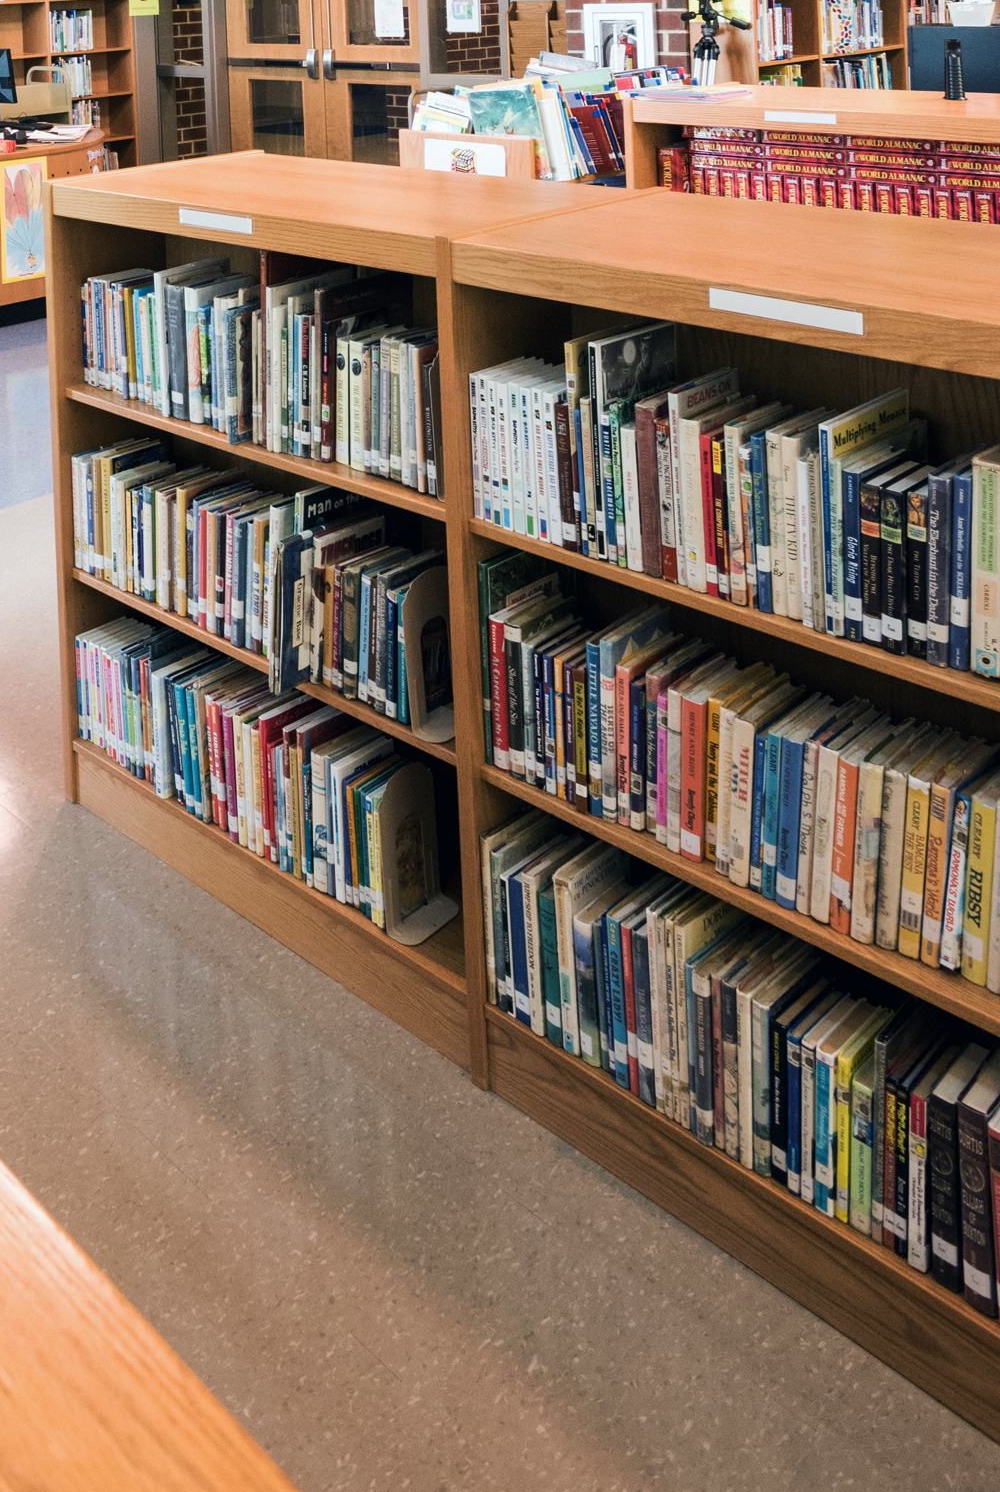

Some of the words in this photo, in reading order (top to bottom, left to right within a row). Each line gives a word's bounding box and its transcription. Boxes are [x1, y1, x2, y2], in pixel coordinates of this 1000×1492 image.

[773, 133, 797, 141] WORLD
[797, 134, 832, 144] ALMANAC
[857, 139, 883, 147] WORLD
[886, 140, 921, 150] ALMANAC
[776, 148, 800, 157] WORLD
[800, 150, 835, 159] ALMANAC
[859, 155, 886, 163] WORLD
[888, 157, 924, 165] ALMANAC
[662, 160, 672, 190] WORLD
[778, 163, 801, 173] WORLD
[802, 166, 836, 175] ALMANAC
[861, 170, 887, 179] WORLD
[890, 172, 927, 182] ALMANAC
[687, 386, 717, 408] BEANS
[718, 379, 732, 393] ON
[425, 406, 433, 452] WHITTINGTON
[833, 417, 878, 450] Multiplying
[878, 406, 907, 424] Menace
[662, 451, 670, 463] The
[663, 464, 671, 500] INCREDIBLE
[308, 499, 332, 518] Man
[334, 499, 344, 508] on
[346, 493, 360, 505] the
[714, 498, 722, 507] THE
[785, 495, 796, 521] THE
[715, 509, 723, 536] COMPUTER
[786, 521, 796, 538] TV
[929, 509, 939, 529] The
[787, 540, 798, 561] KID
[847, 536, 858, 559] Gloria
[928, 530, 939, 571] Elephant
[847, 561, 859, 584] Rising
[863, 568, 868, 576] OF
[929, 571, 938, 581] in
[295, 582, 303, 619] Graeme
[929, 581, 938, 598] the
[929, 599, 938, 621] Dark
[491, 656, 499, 668] AL
[492, 670, 501, 700] CAPONE
[508, 666, 516, 685] Shen
[589, 662, 598, 700] LITTLE
[508, 687, 516, 695] of
[575, 683, 583, 696] Too
[493, 702, 501, 721] DOES
[509, 696, 517, 708] the
[576, 697, 584, 709] Hot
[576, 710, 583, 718] To
[589, 702, 599, 743] NAVAJO
[646, 708, 656, 729] Dear
[688, 711, 696, 736] HENRY
[494, 723, 503, 737] MY
[576, 718, 584, 739] Handle
[646, 741, 656, 778] Henshaw
[707, 741, 719, 762] Henry
[709, 763, 718, 776] and
[738, 745, 750, 803] MITCH
[709, 777, 718, 788] the
[802, 770, 813, 807] Ralph
[838, 766, 846, 802] RAMONA
[686, 788, 696, 811] Beverly
[708, 790, 718, 823] Clubhouse
[931, 792, 946, 823] CLEARY
[686, 810, 696, 831] Cleary
[912, 801, 921, 831] CLEARY
[780, 827, 789, 850] Beverly
[800, 823, 811, 855] Mouse
[836, 817, 845, 847] FATHER
[905, 832, 914, 850] THE
[972, 812, 982, 859] CLEARY
[780, 851, 788, 872] Cleary
[904, 852, 913, 873] PEST
[913, 835, 925, 875] RAMONA
[927, 834, 943, 887] Ramona's
[949, 849, 961, 898] RAMONA'S
[925, 888, 939, 920] World
[967, 866, 983, 929] RIBSY
[526, 922, 533, 931] TO
[945, 900, 956, 932] WORLD
[527, 931, 535, 970] FREEDOM
[610, 951, 620, 988] CRAZY
[612, 988, 622, 1023] LADY!
[818, 1104, 828, 1150] Bloomability
